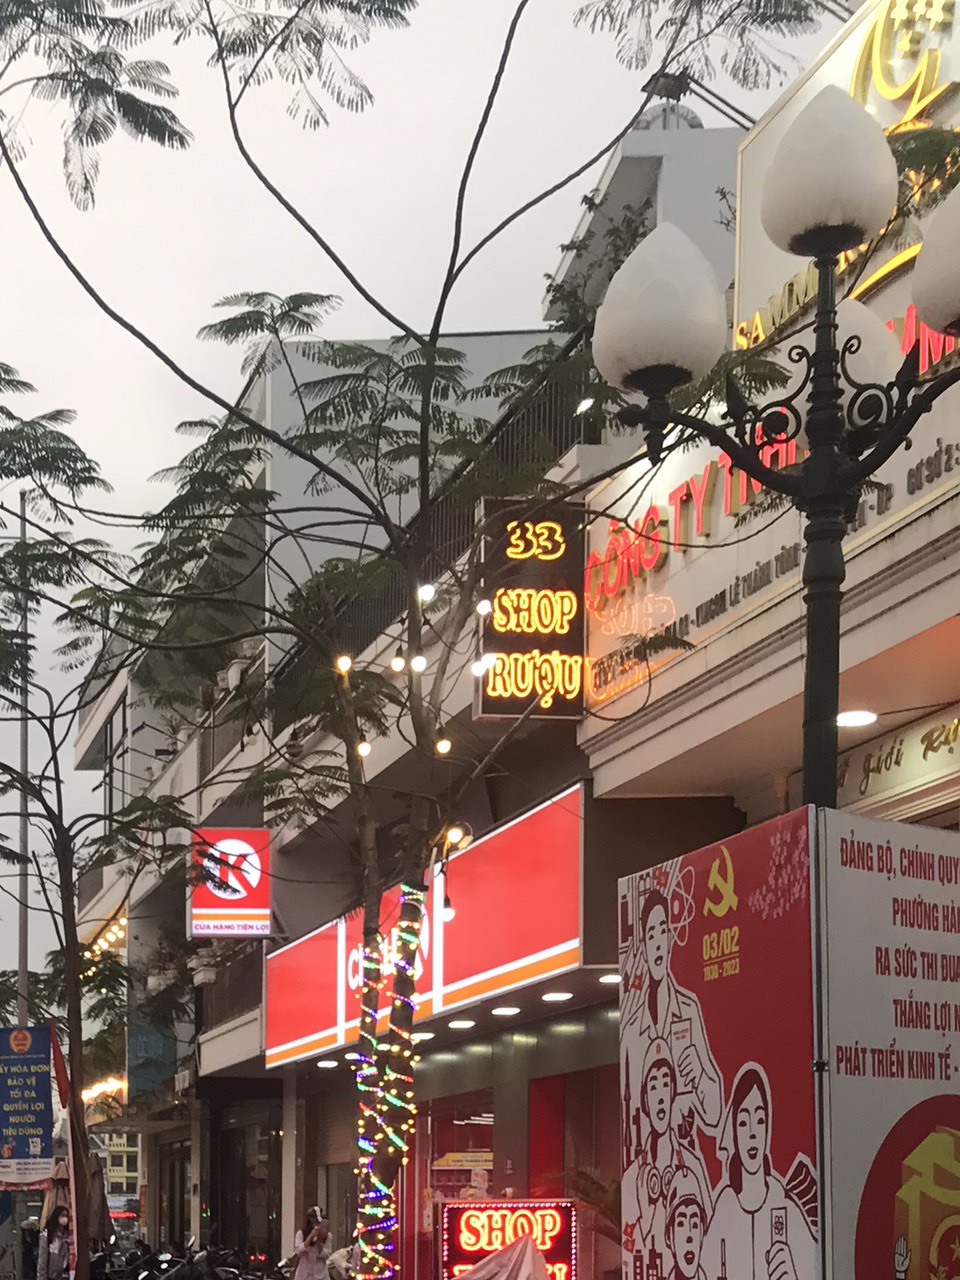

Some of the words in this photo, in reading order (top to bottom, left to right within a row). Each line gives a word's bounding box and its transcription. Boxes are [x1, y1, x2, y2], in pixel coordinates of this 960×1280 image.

[506, 519, 567, 561] 33
[584, 505, 662, 612] CÔNG
[493, 588, 578, 635] SHOP
[486, 649, 582, 709] RƯỢU
[840, 829, 874, 873] ĐẢNG
[877, 839, 897, 881] BỘ,
[899, 843, 935, 882] CHÍNH
[938, 853, 960, 887] QUY
[213, 922, 235, 931] HÀNG
[892, 893, 939, 932] PHƯỜNG
[703, 926, 739, 960] 03/02
[875, 946, 891, 976] RA
[894, 943, 917, 979] SỨC
[920, 951, 938, 981] THI
[893, 988, 931, 1030] THẮNG
[934, 1000, 951, 1038] LỢI
[836, 1040, 867, 1077] PHÁT
[870, 1037, 904, 1079] TRIỂN
[907, 1050, 935, 1080] KINH
[938, 1043, 952, 1081] TẾ
[459, 1208, 561, 1252] SHOP
